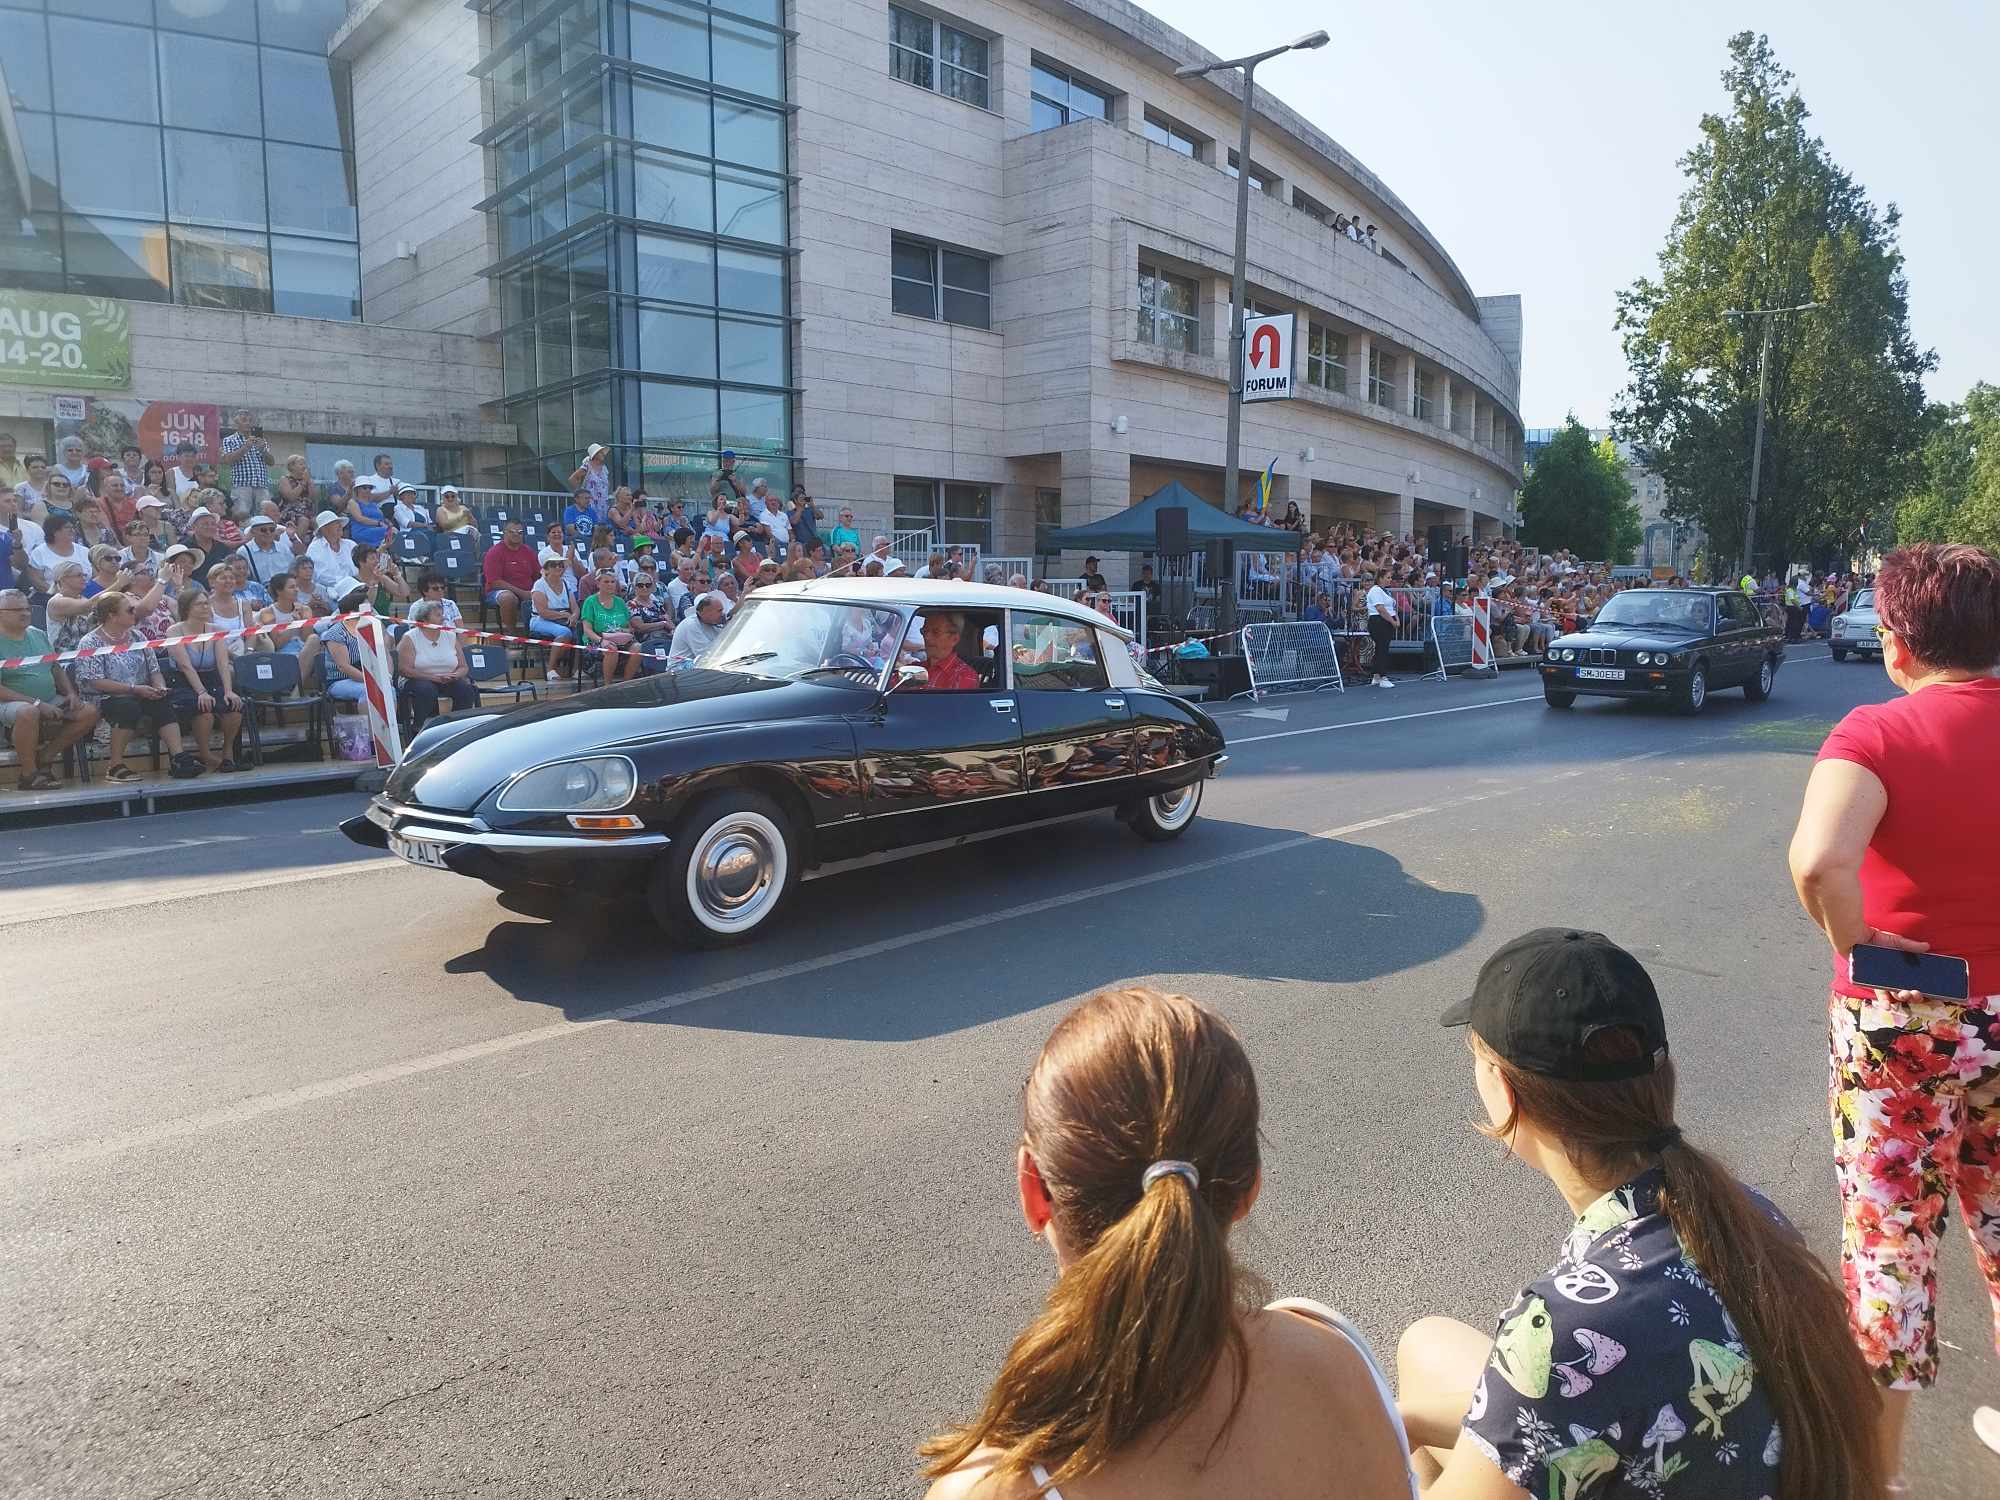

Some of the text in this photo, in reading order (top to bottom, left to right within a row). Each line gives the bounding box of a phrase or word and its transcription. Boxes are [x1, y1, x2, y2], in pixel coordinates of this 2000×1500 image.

[0, 307, 82, 341] AUG
[1246, 377, 1287, 392] FORUM
[161, 408, 205, 431] JÚN
[161, 430, 208, 447] 16-18.
[418, 841, 441, 864] ALT
